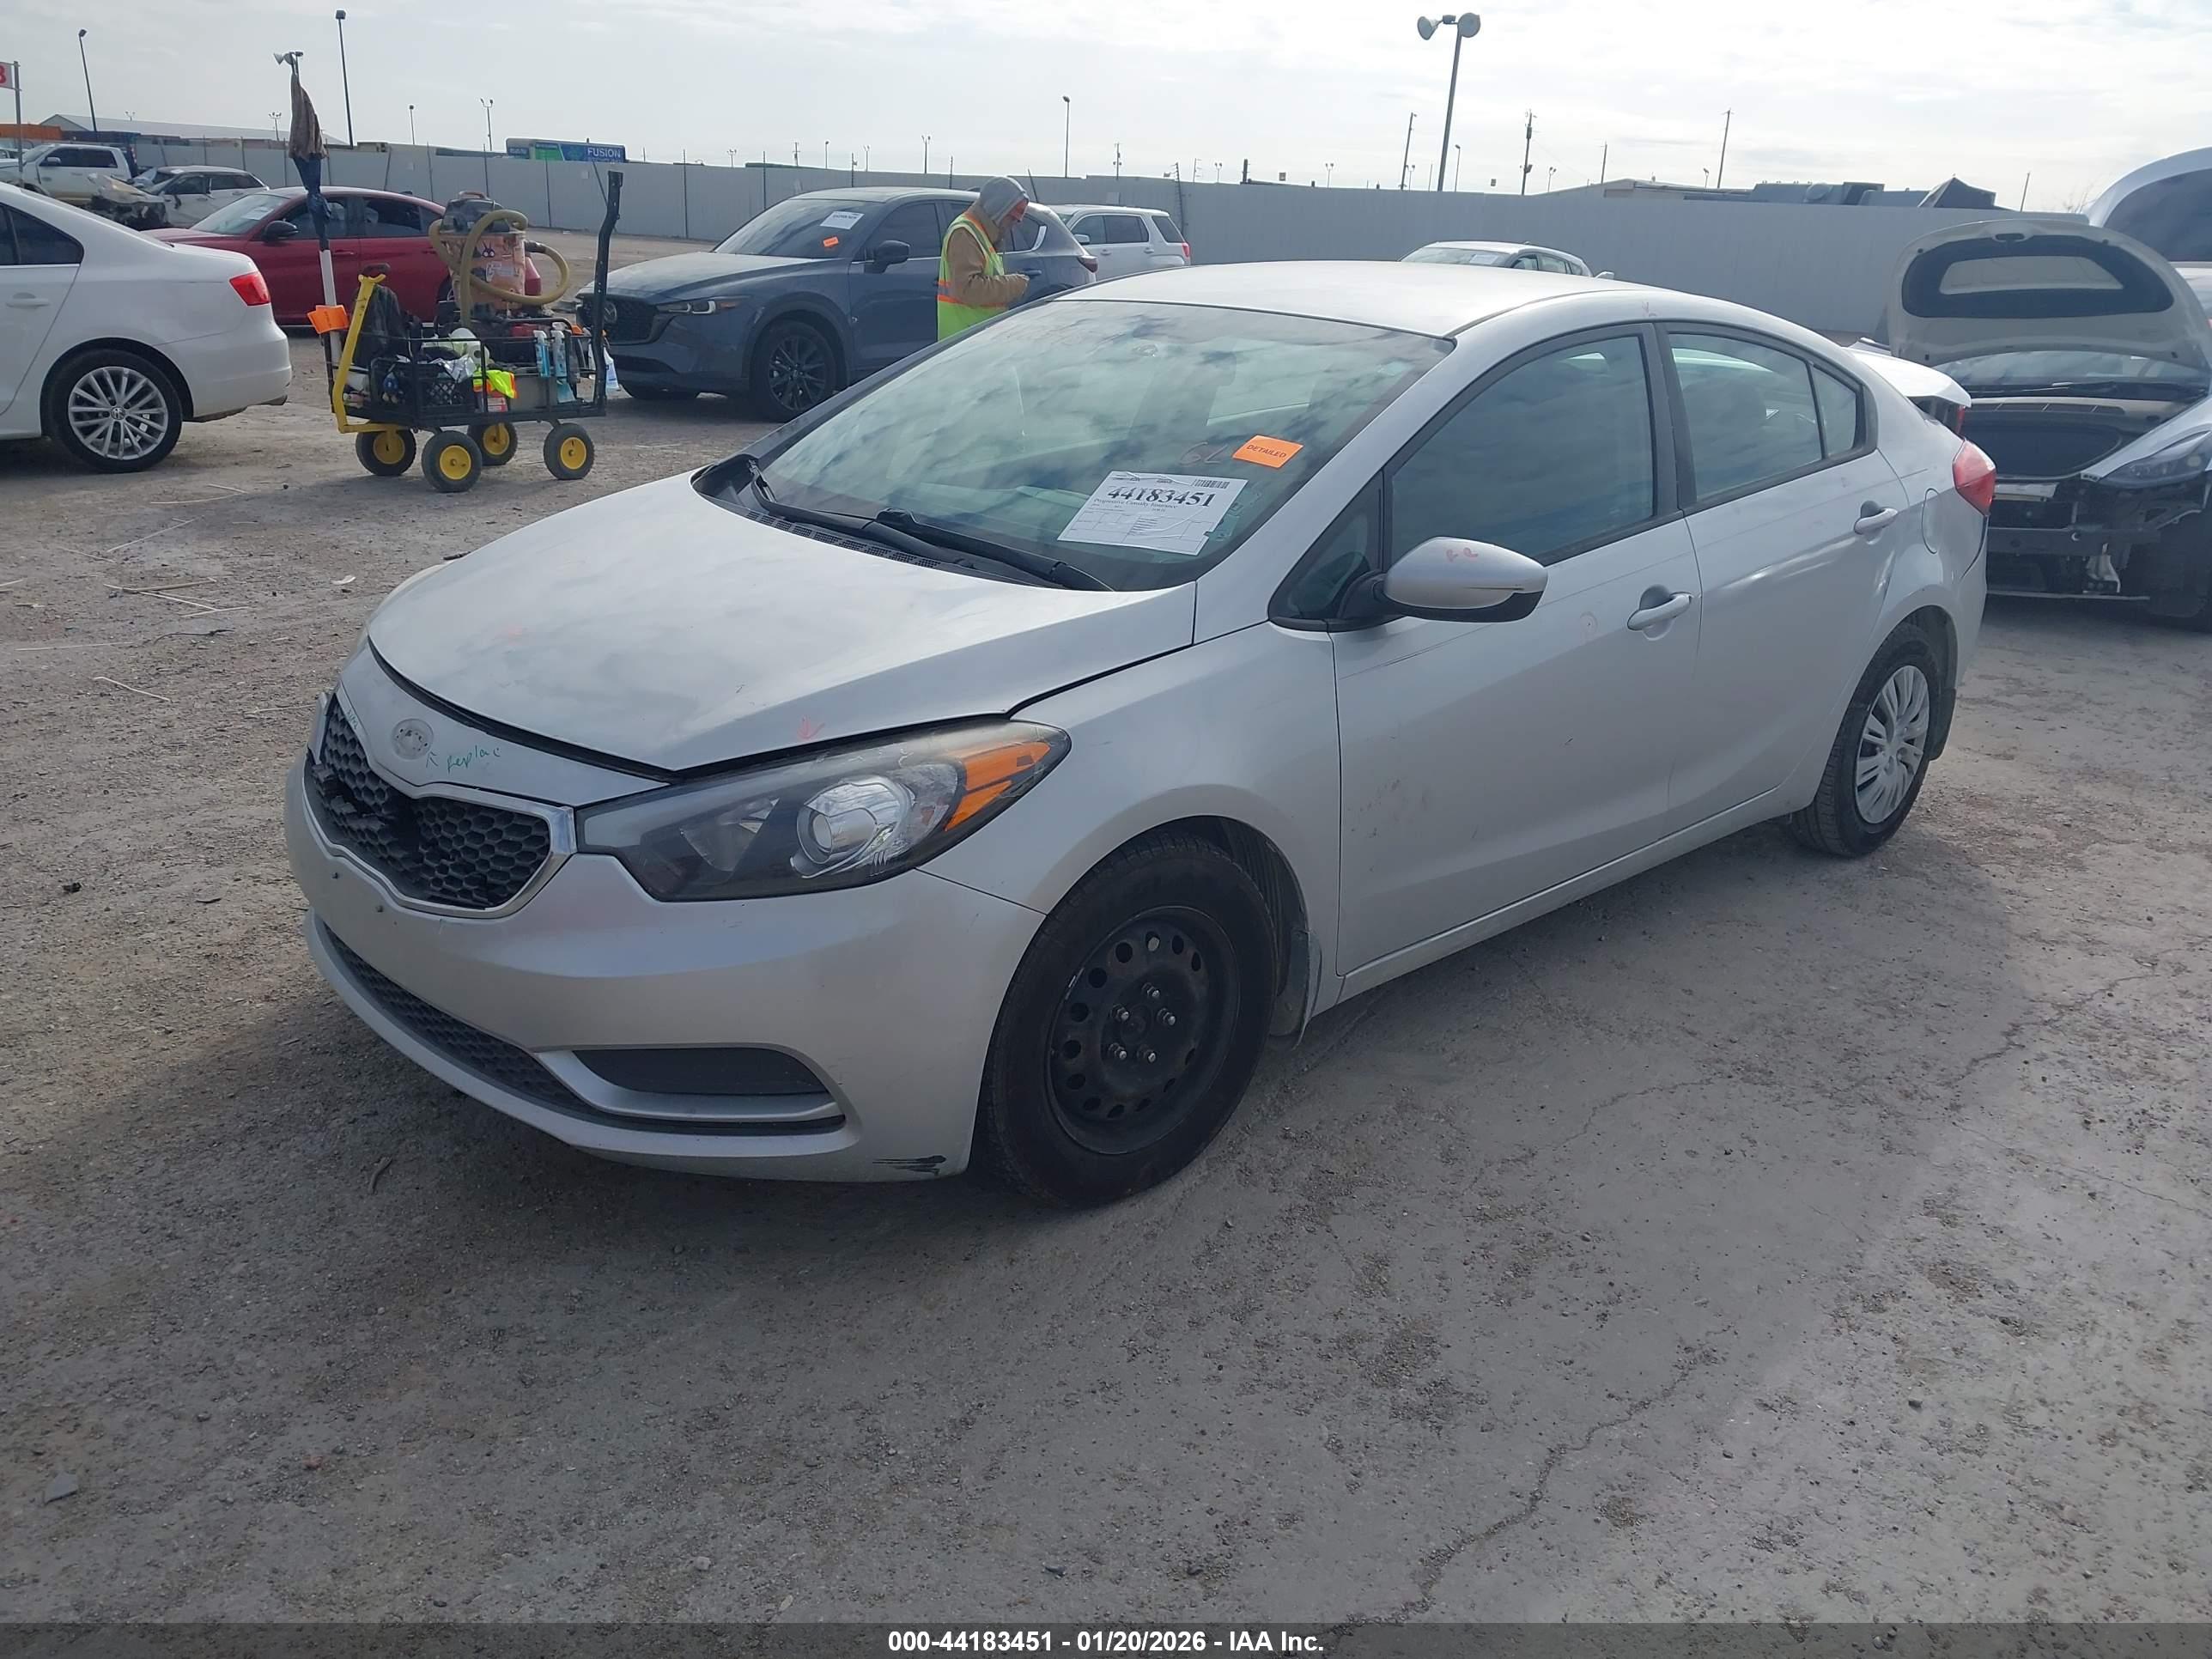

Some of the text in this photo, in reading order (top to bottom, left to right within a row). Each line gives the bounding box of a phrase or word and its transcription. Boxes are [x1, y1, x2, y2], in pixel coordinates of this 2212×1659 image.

[586, 147, 622, 159] FUSION
[1246, 444, 1288, 459] DETAILED
[1107, 486, 1216, 507] 44183451
